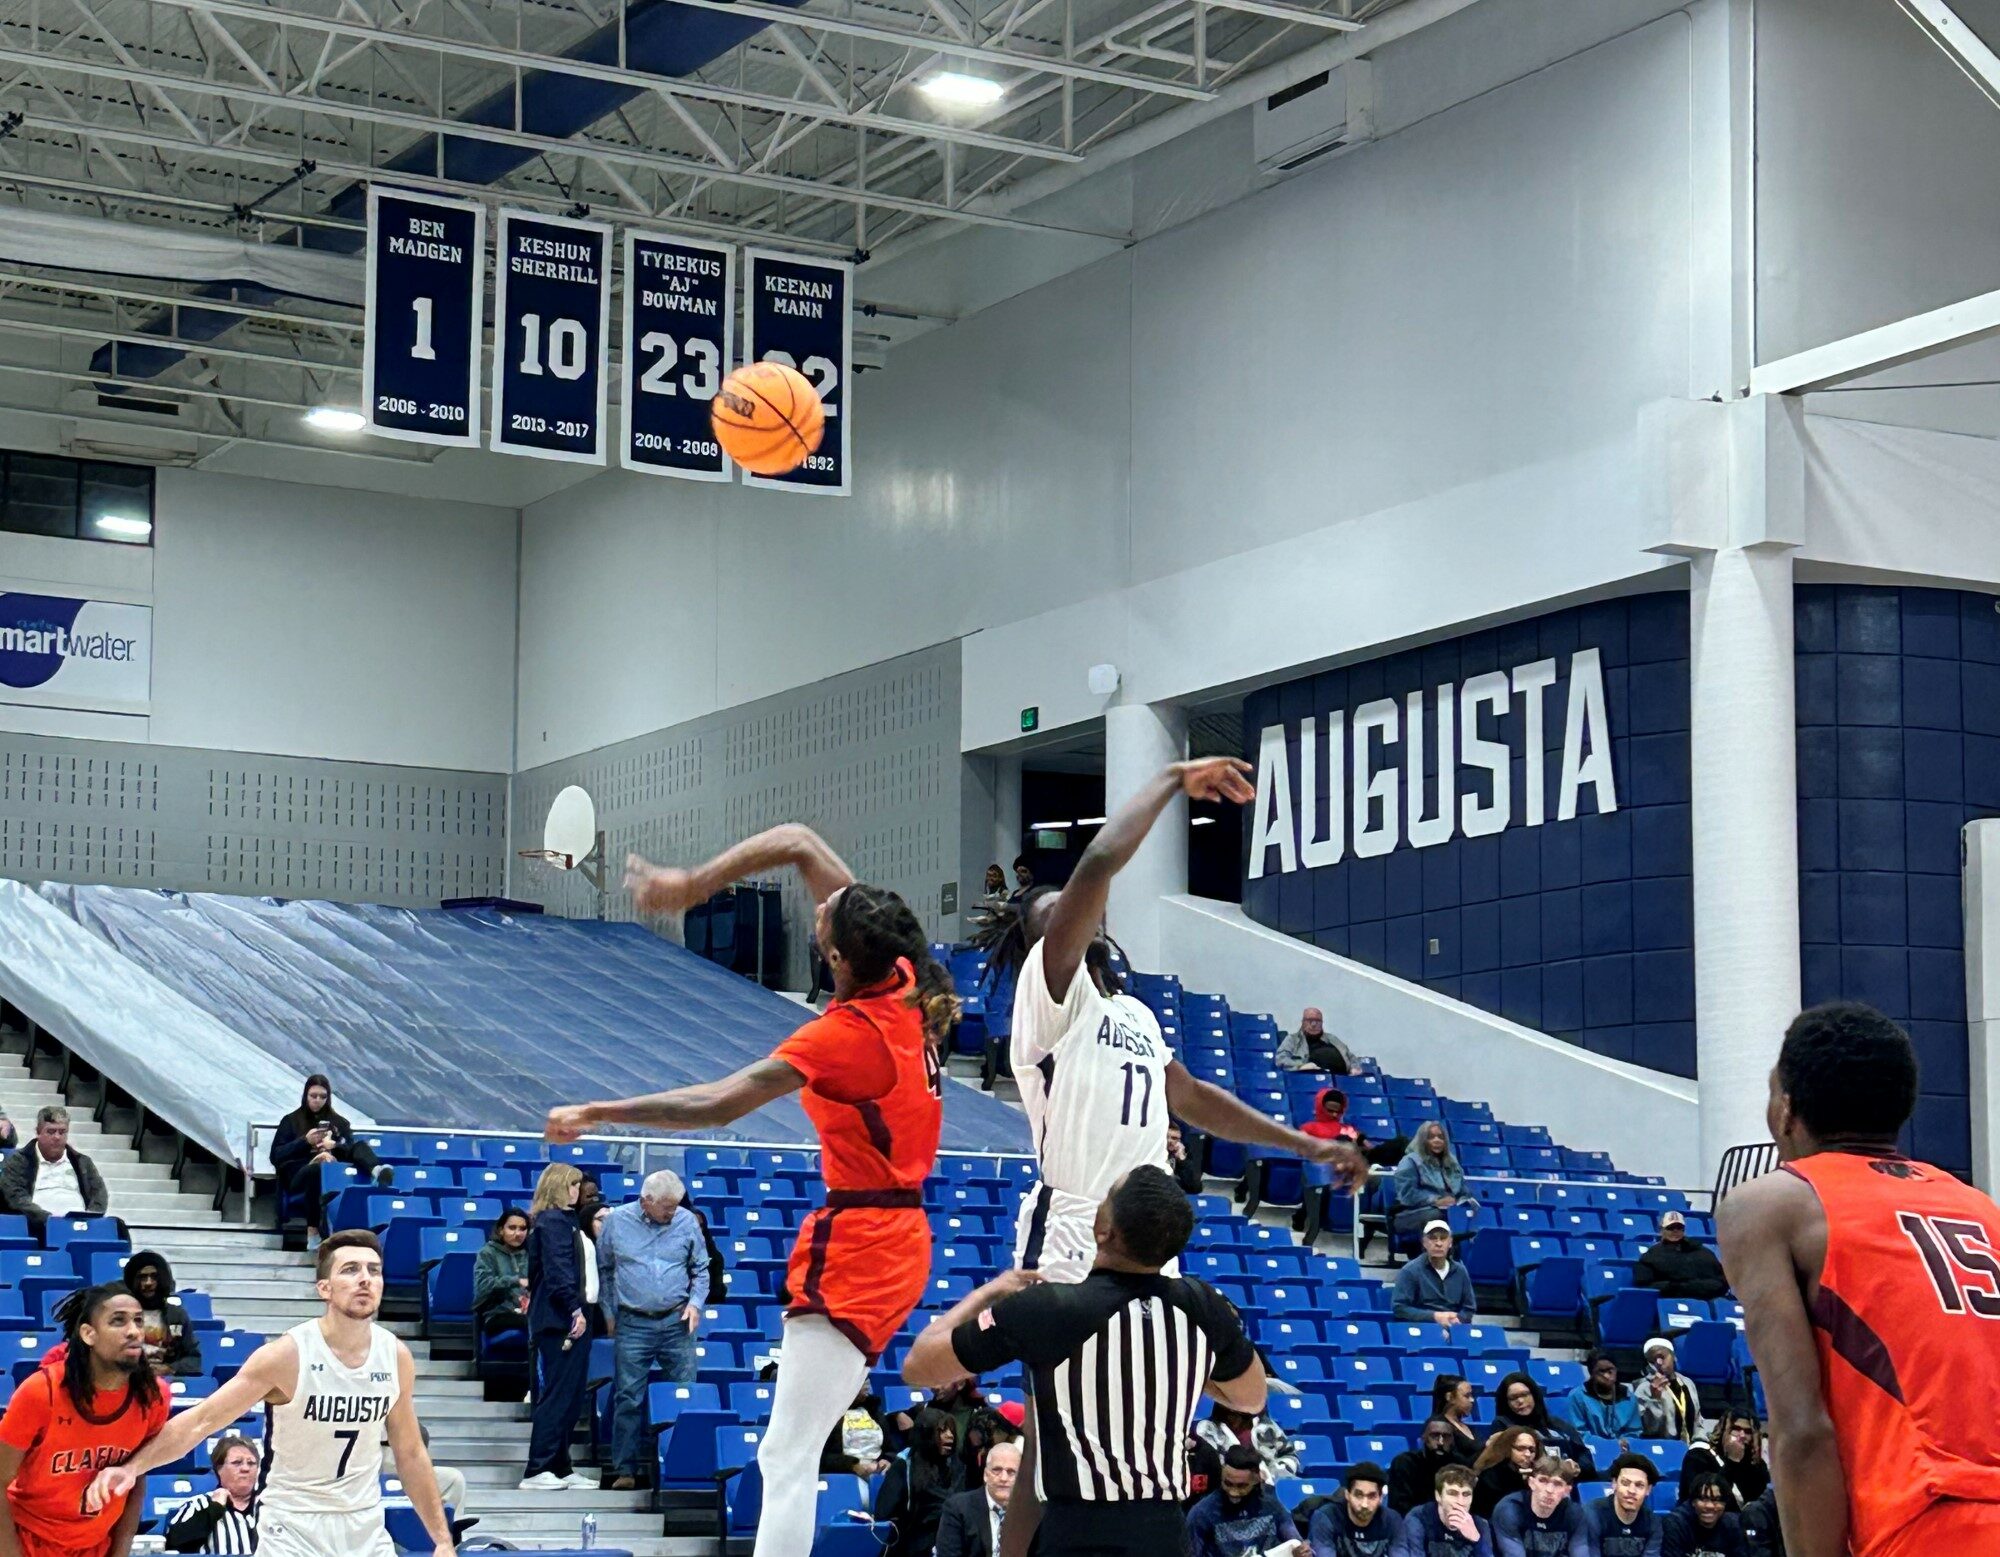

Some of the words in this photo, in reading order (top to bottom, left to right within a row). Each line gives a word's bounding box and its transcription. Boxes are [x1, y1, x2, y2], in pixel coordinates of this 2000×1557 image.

[409, 218, 445, 239] BEN
[389, 236, 462, 264] MADGEN
[519, 236, 591, 263] KESHUN
[640, 250, 721, 277] TYREKUS
[511, 257, 598, 285] SHERRILL
[662, 274, 699, 294] "AJ"
[765, 275, 833, 300] KEENAN
[642, 290, 717, 316] BOWMAN
[774, 297, 823, 319] MANN
[411, 297, 436, 360] 1
[520, 313, 587, 380] 10
[640, 331, 720, 401] 23
[762, 350, 838, 416] 2
[1248, 647, 1617, 880] AUGUSTA
[1895, 1210, 2000, 1320] 15
[303, 1395, 390, 1423] AUGUSTA
[334, 1430, 360, 1479] 7
